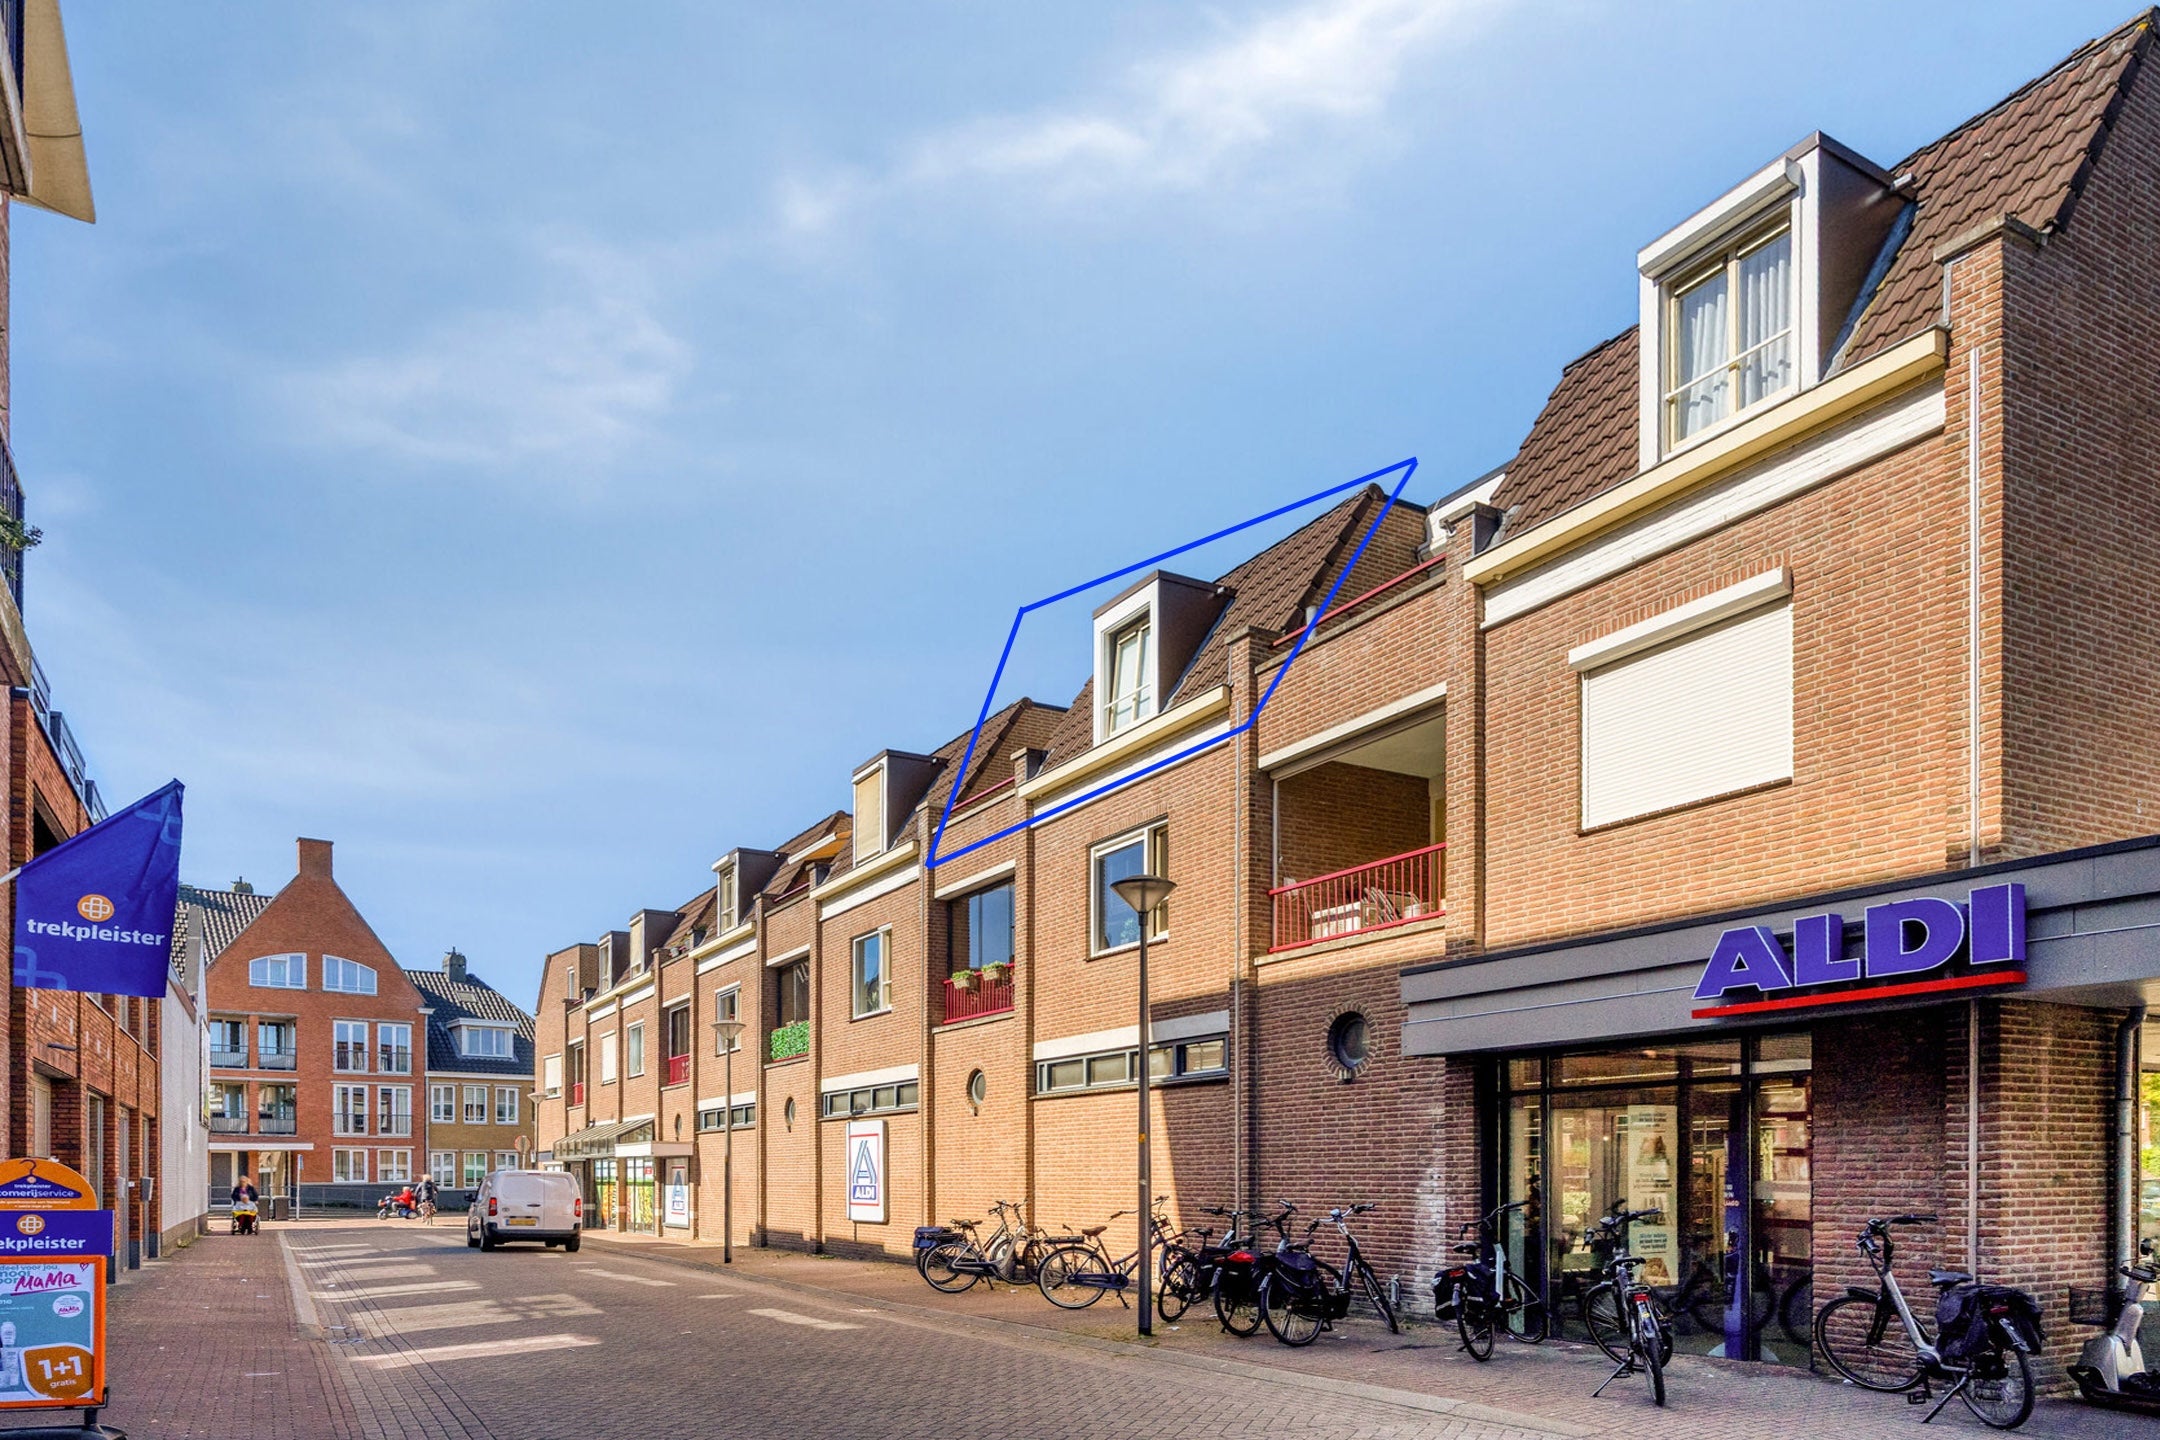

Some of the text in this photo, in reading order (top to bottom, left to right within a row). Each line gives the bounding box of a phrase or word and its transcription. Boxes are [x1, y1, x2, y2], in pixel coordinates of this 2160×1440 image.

[26, 918, 166, 946] trekpleister
[1691, 883, 2026, 1000] ALDI
[854, 1186, 875, 1199] ALDI
[38, 1355, 83, 1380] 1+1
[50, 1379, 77, 1389] gratis
